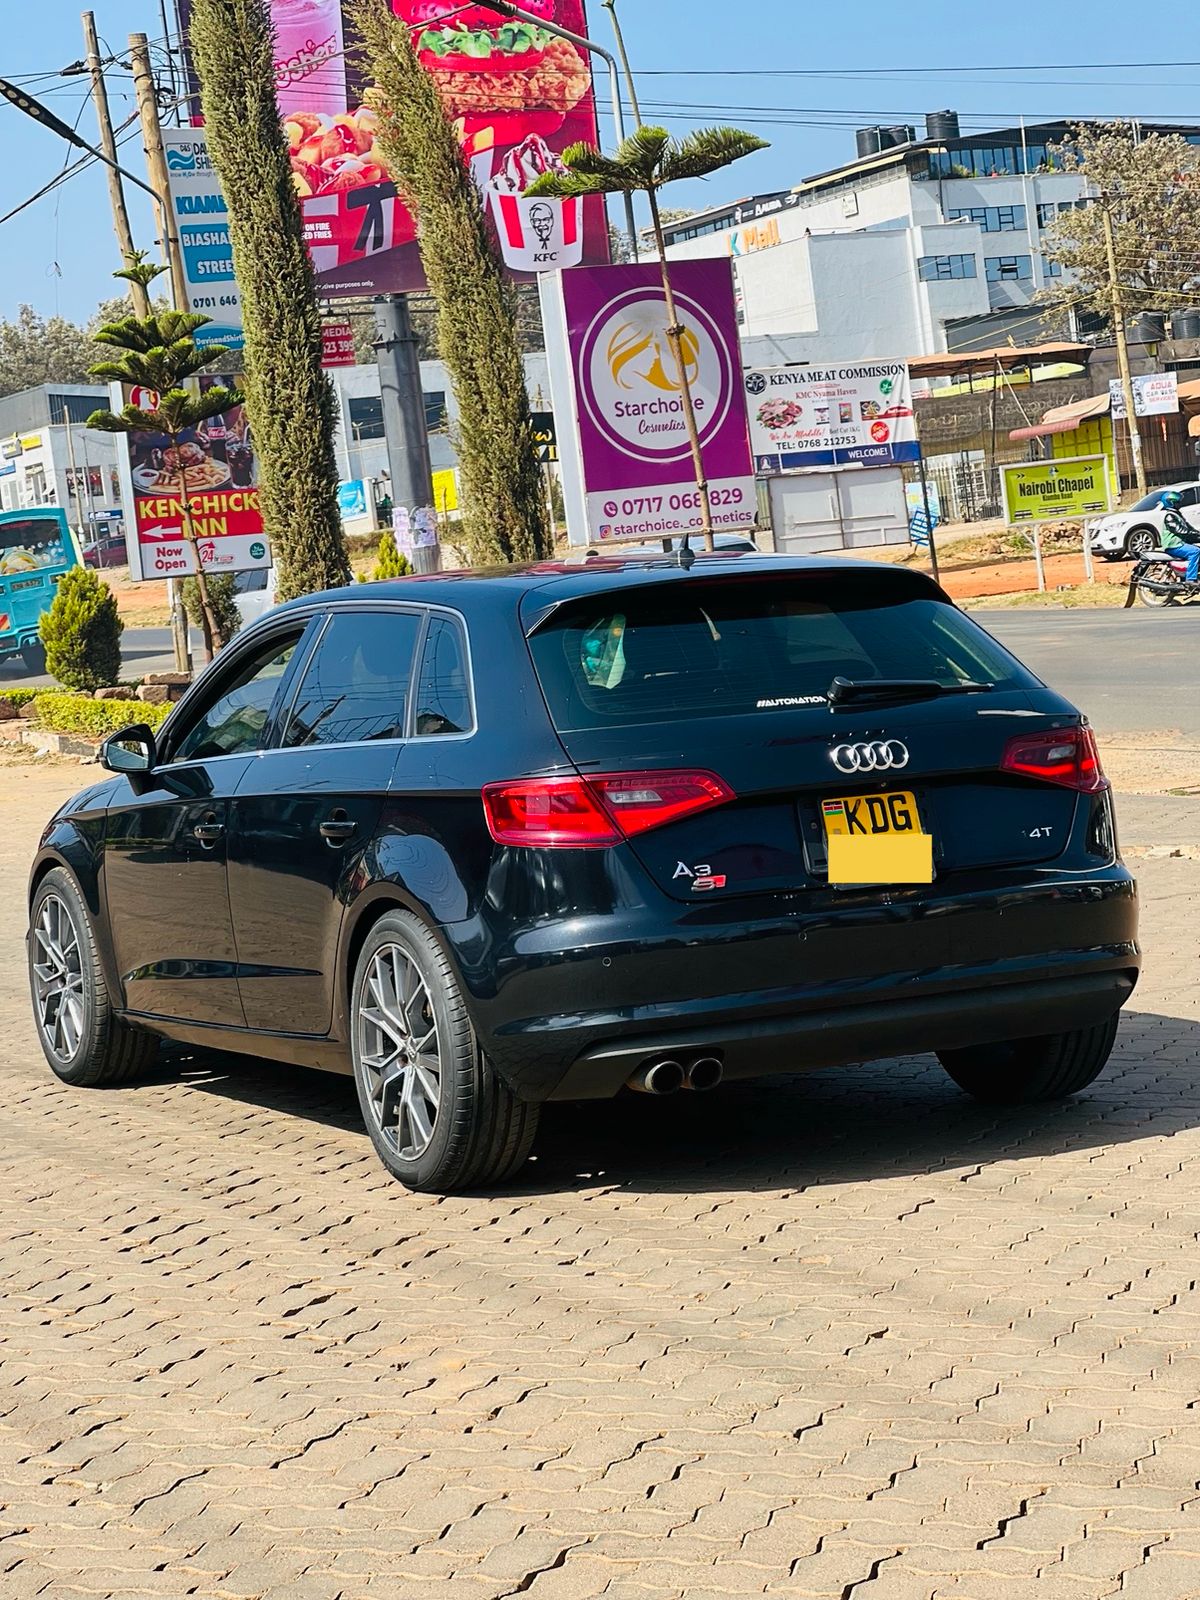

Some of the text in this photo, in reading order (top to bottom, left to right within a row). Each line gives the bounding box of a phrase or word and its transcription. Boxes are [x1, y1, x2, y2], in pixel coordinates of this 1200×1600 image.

[193, 142, 208, 155] DA
[313, 230, 332, 239] FRIES
[315, 222, 330, 231] FIRE
[182, 231, 231, 247] BIASHA
[725, 217, 781, 256] K Mall
[533, 251, 557, 262] KFC
[197, 259, 234, 275] STREE
[335, 281, 360, 289] purposes
[193, 295, 237, 308] 0701 646
[770, 374, 806, 386] KENYA
[808, 370, 836, 382] MEAT
[839, 364, 905, 380] COMMISSION
[614, 397, 704, 418] Starchoie
[638, 419, 686, 435] Cosmetics
[776, 435, 857, 450] TEL: 0768 212753
[847, 447, 889, 459] WELCOME!
[1019, 476, 1094, 496] Nairobi Chapel
[140, 491, 260, 519] KENCHICK
[622, 488, 743, 516] 0717 068 829
[182, 516, 228, 539] INN
[614, 510, 752, 536] starchoice._cometics
[156, 547, 183, 558] Now
[201, 550, 214, 563] 24
[155, 559, 187, 572] Open
[842, 793, 913, 836] KDG
[672, 860, 712, 880] A3
